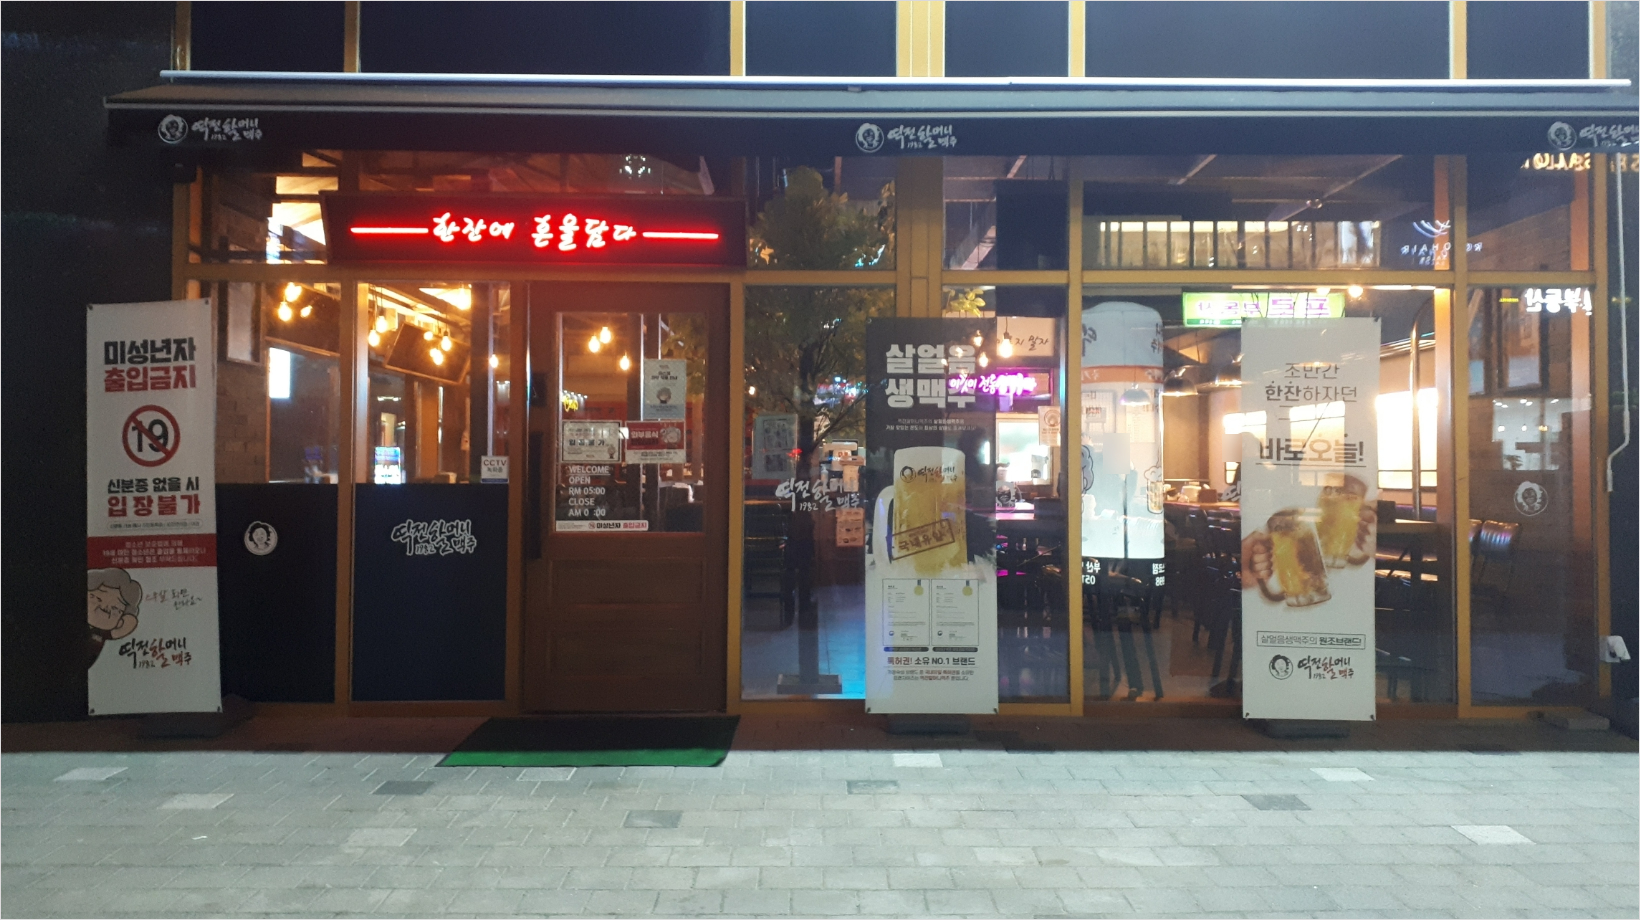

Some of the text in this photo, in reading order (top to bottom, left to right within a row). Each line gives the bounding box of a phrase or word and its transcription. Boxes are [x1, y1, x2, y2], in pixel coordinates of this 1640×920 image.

[433, 212, 515, 242] 한잔에
[104, 336, 196, 365] 미성년자
[886, 343, 976, 374] 살얼음
[104, 364, 197, 392] 출입금지
[1284, 362, 1340, 379] 조만간
[885, 378, 976, 408] 생맥주
[132, 419, 168, 453] 19
[568, 465, 610, 474] WELCOME
[107, 476, 199, 494] 신분증 없을 시
[568, 476, 591, 484] OPEN
[568, 486, 606, 495] RM 05:00
[568, 498, 595, 506] CLOSE
[799, 501, 819, 511] 1982
[567, 508, 581, 517] AM
[391, 519, 472, 556] 역전할머니
[1261, 634, 1362, 646] 살얼음생맥주의 원조브랜드!
[119, 637, 187, 669] 역전할머니
[172, 651, 191, 667] 맥주
[887, 656, 976, 666] 특허권! 소유 NO.1 브랜드
[1297, 655, 1351, 680] 역전할머니
